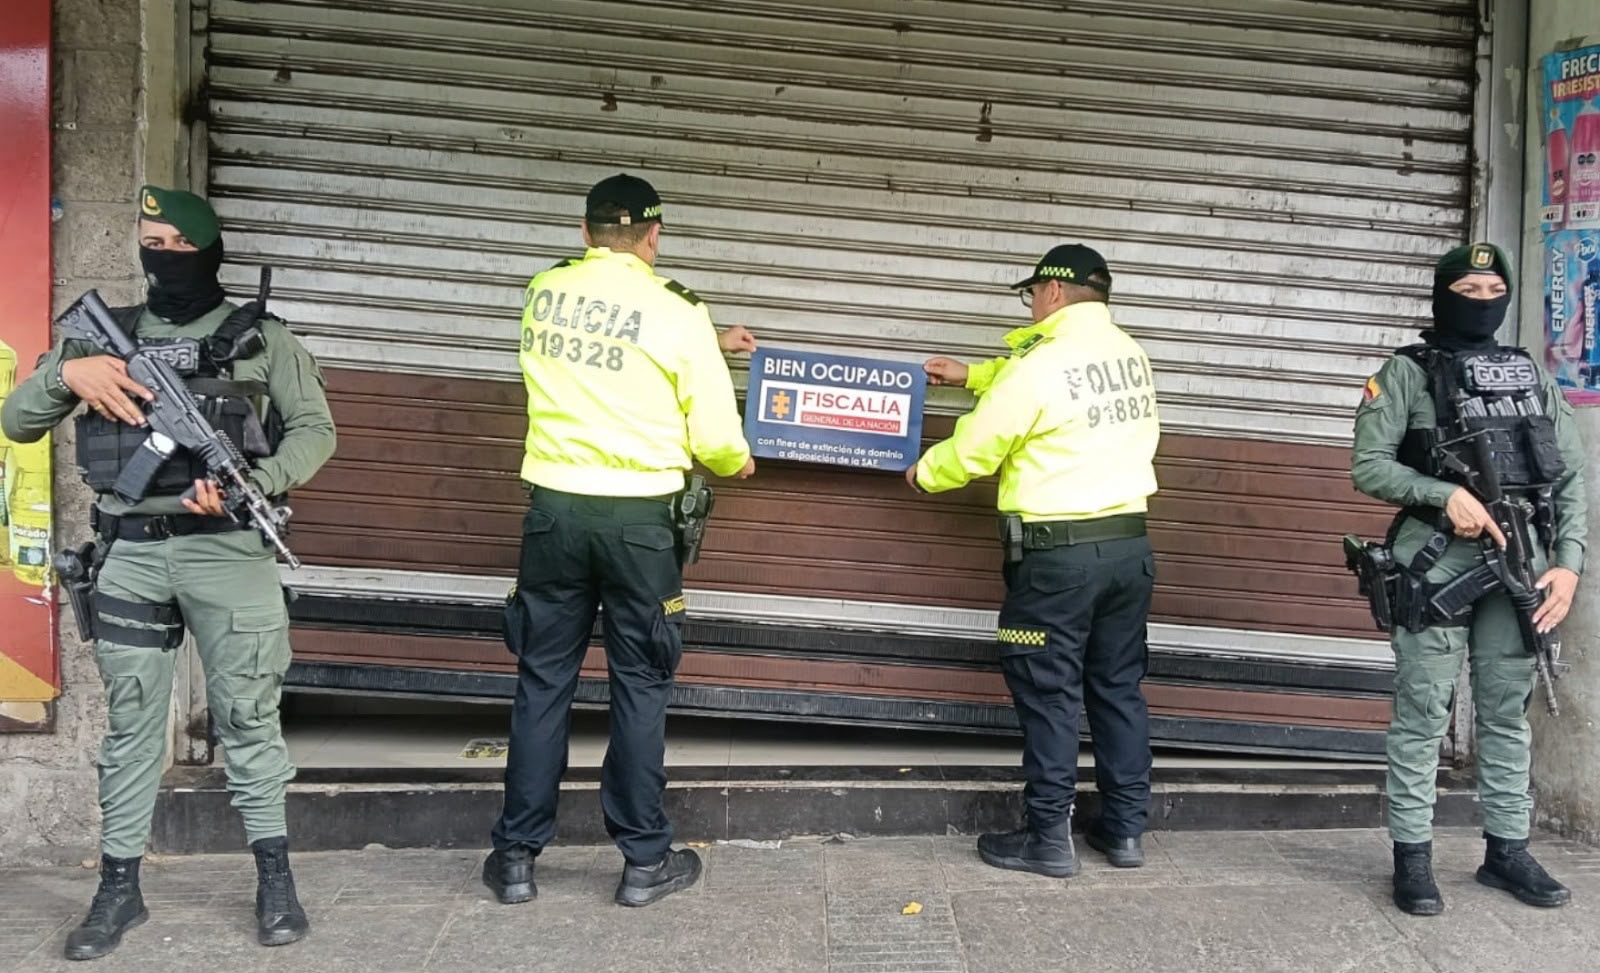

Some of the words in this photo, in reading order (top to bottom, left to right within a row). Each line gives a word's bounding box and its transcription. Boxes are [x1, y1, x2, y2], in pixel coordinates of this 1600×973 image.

[1551, 249, 1566, 333] ENERGY
[523, 287, 642, 344] POLICIA
[522, 327, 624, 372] 919328
[764, 357, 806, 378] BIEN
[811, 363, 912, 389] OCUPADO
[1477, 366, 1533, 382] GOES
[802, 391, 901, 416] FISCALÍA
[1088, 393, 1156, 428] 91882
[803, 413, 840, 426] GENERAL
[843, 418, 854, 427] DE
[856, 420, 866, 428] LA
[867, 420, 899, 432] NACIÓN
[757, 438, 775, 446] con
[776, 438, 797, 448] fines
[798, 441, 811, 449] de
[812, 443, 852, 454] extinción
[854, 447, 866, 456] de
[868, 448, 904, 460] dominio
[787, 450, 836, 464] disposición
[837, 455, 849, 464] de
[851, 456, 860, 465] la
